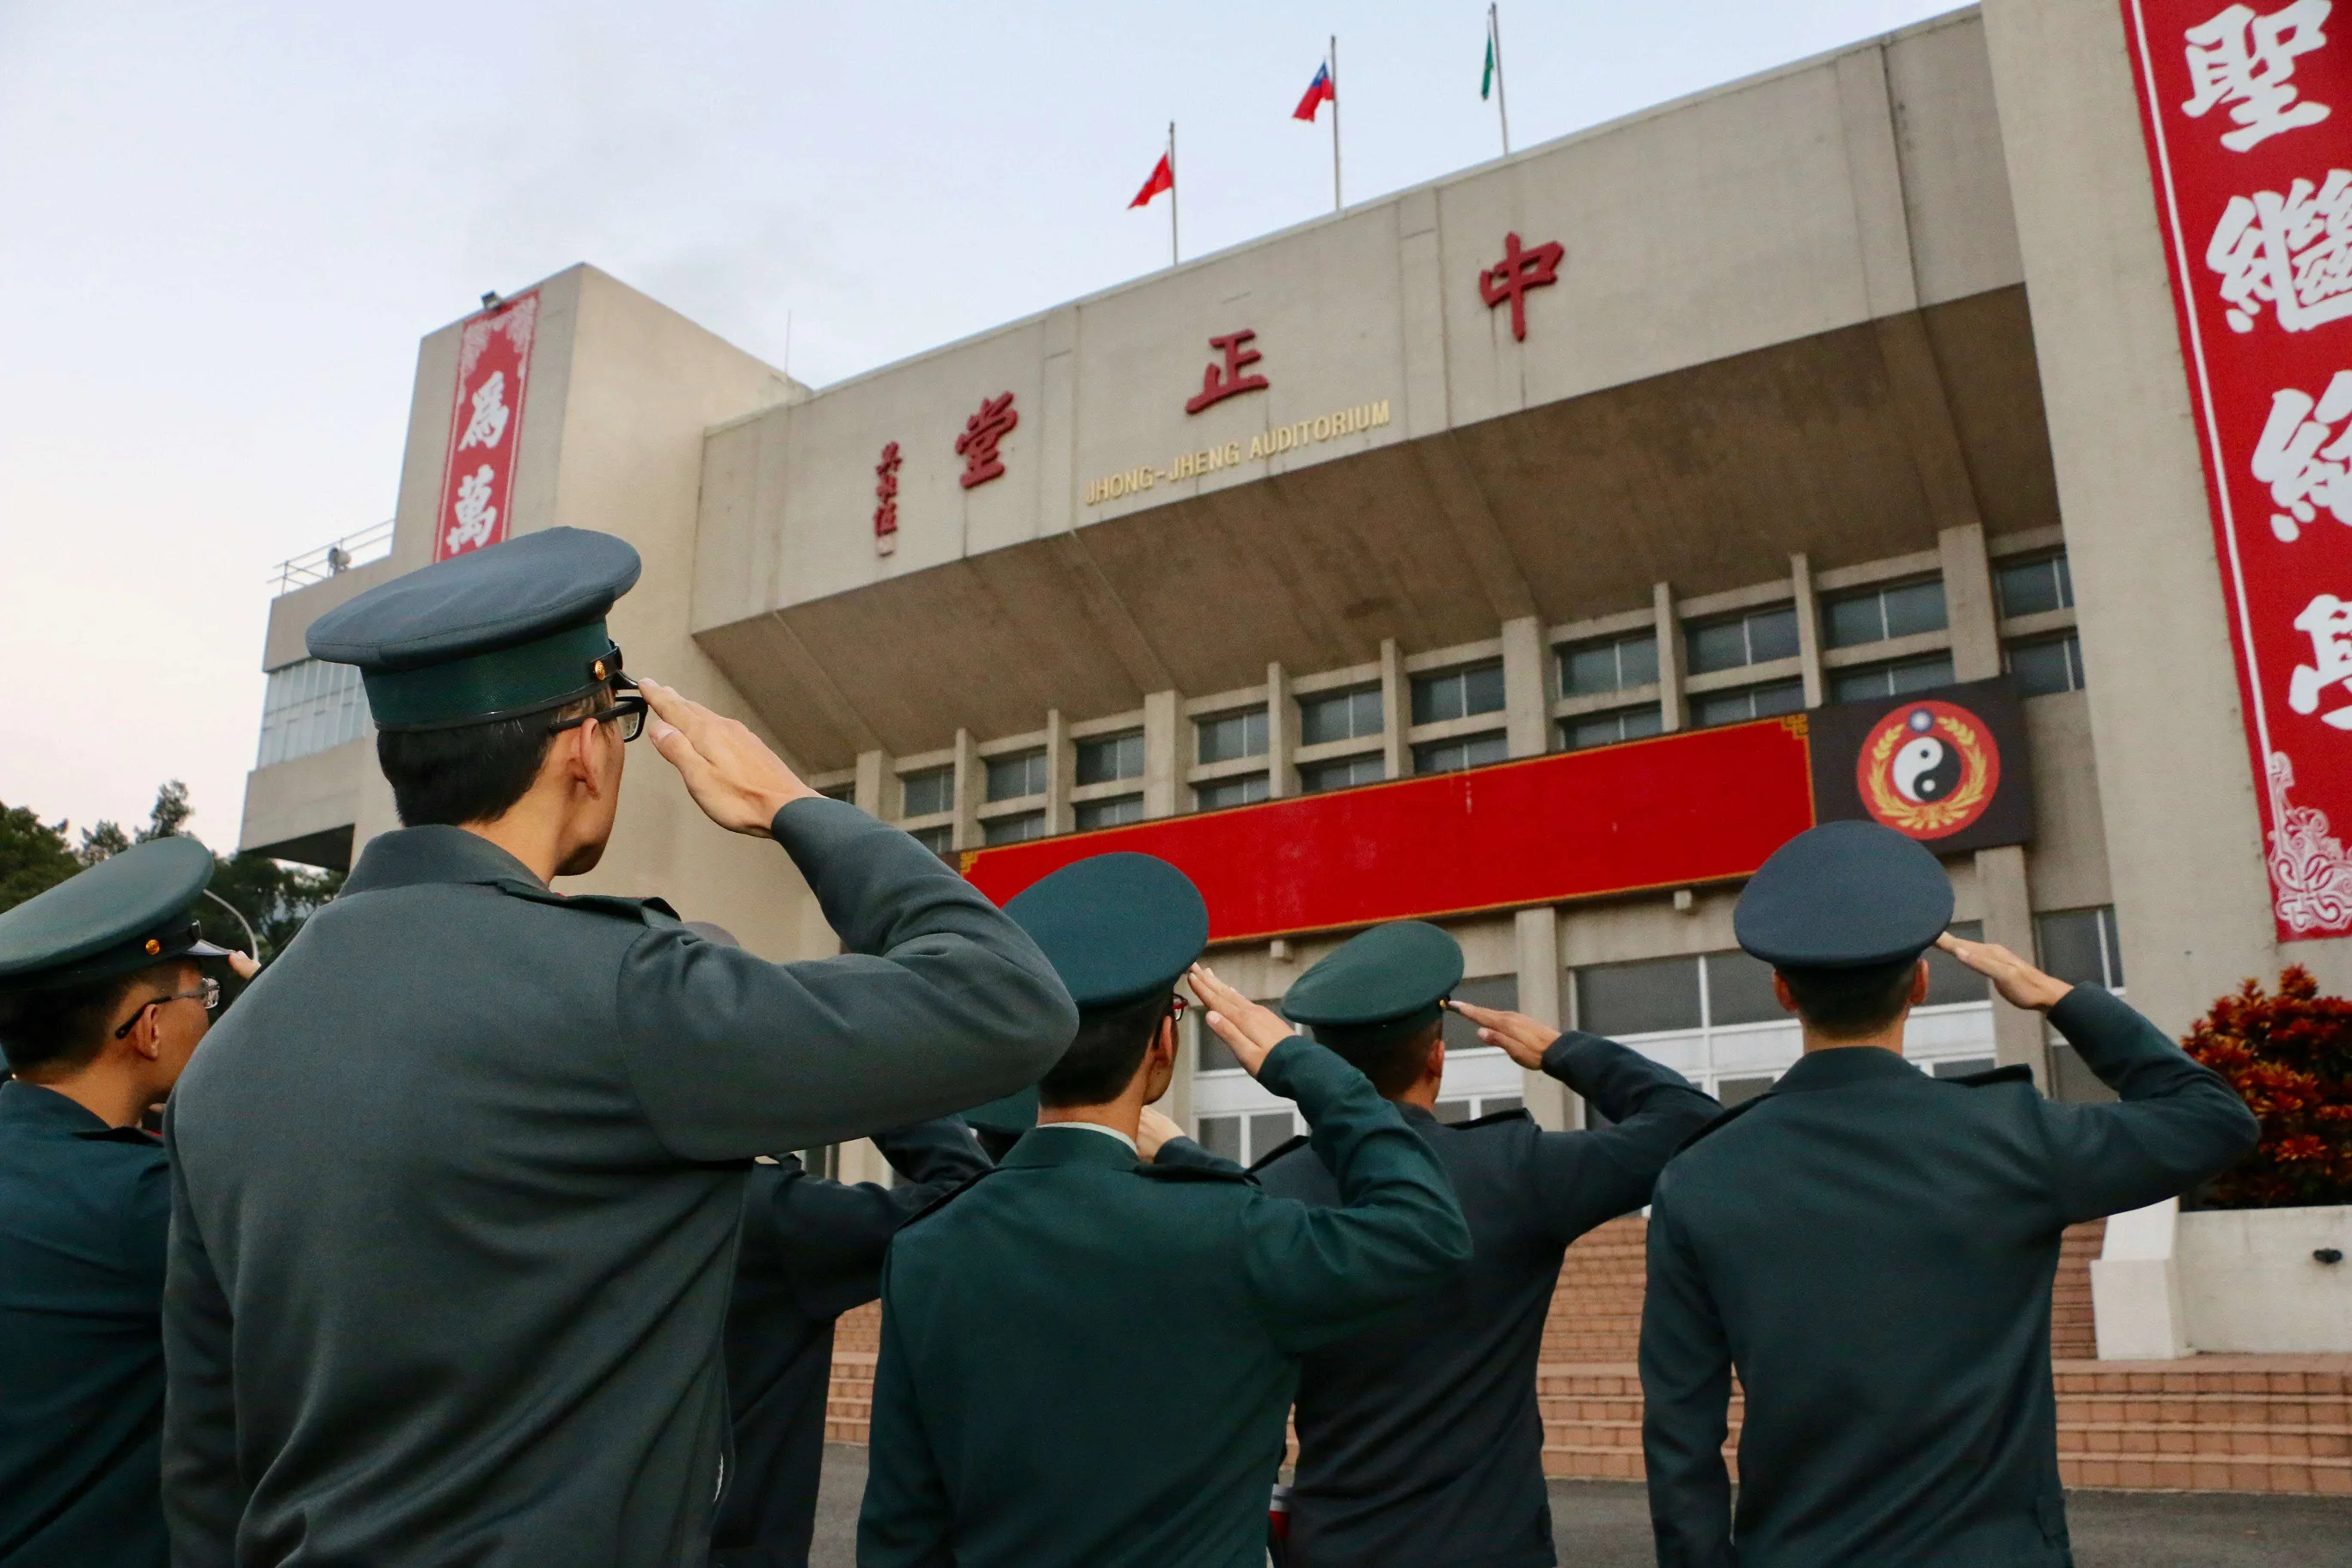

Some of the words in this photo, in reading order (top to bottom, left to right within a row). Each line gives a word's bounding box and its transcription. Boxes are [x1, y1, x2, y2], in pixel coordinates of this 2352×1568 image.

[954, 230, 1565, 489] 中正堂
[1083, 442, 1240, 506] JHONG-JHENG
[1248, 399, 1391, 459] AUDITORIUM
